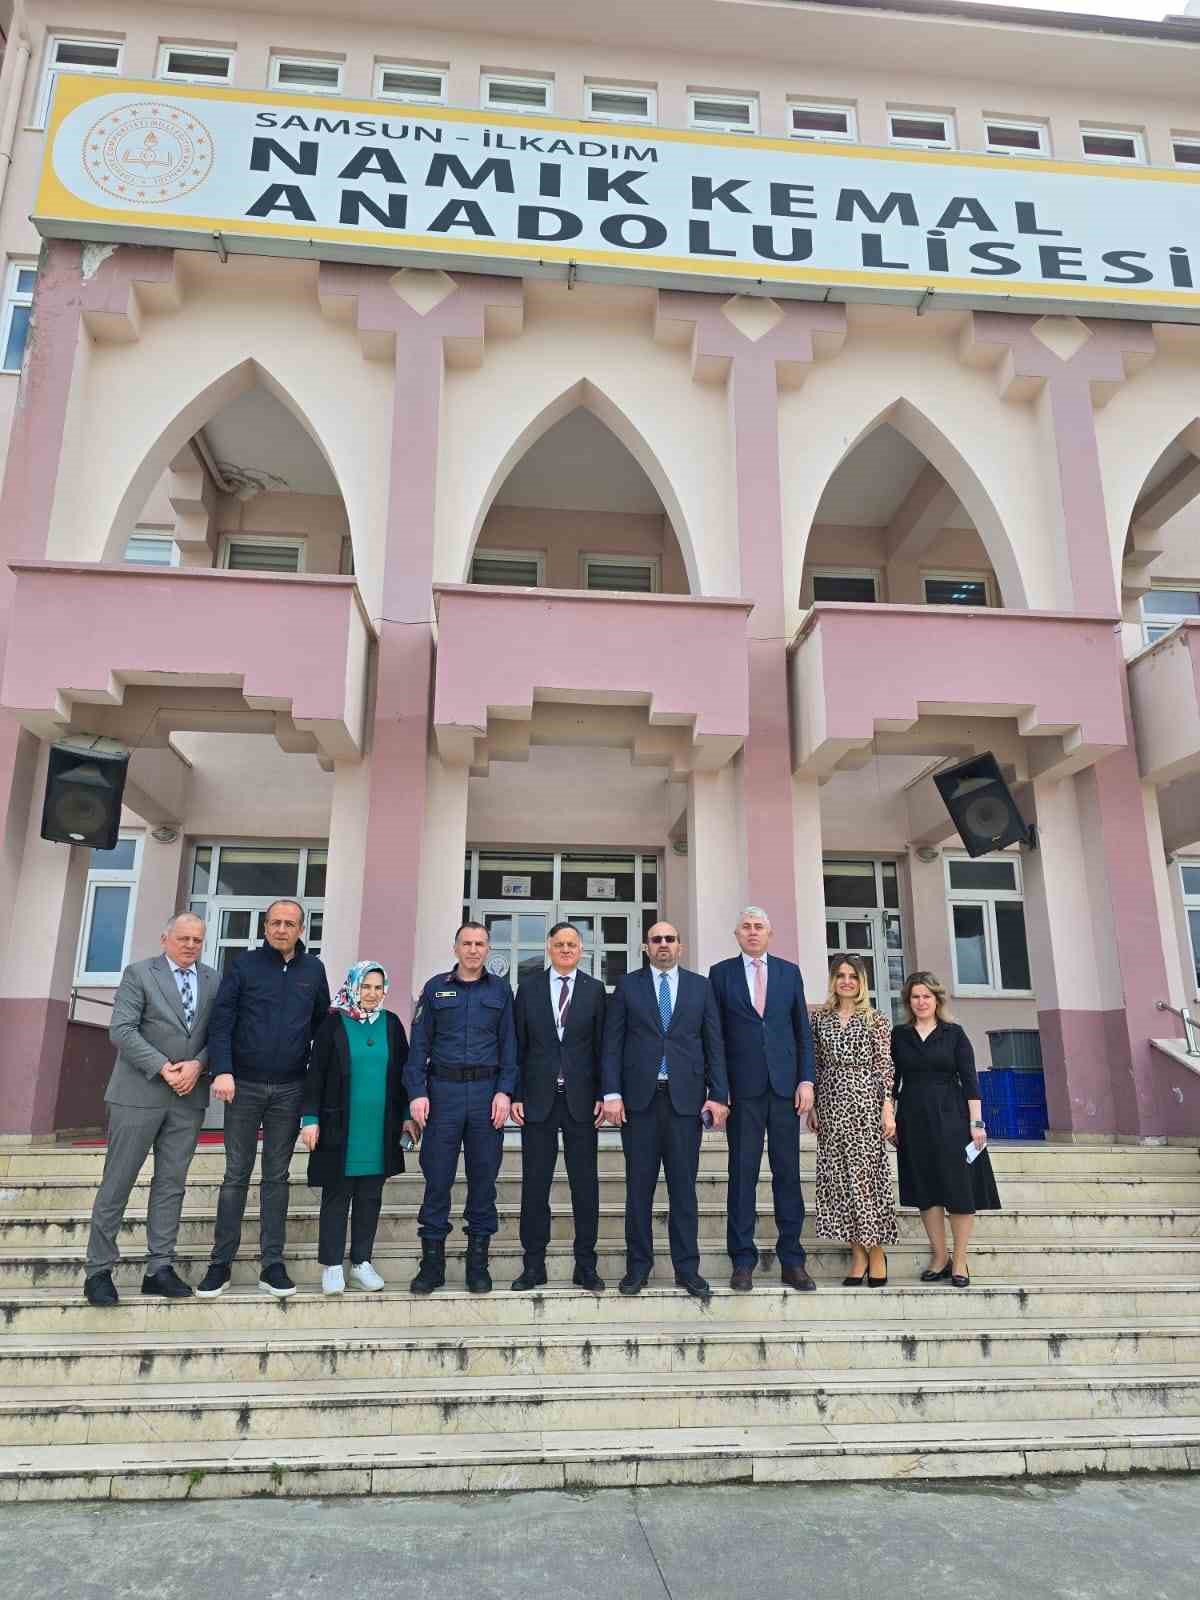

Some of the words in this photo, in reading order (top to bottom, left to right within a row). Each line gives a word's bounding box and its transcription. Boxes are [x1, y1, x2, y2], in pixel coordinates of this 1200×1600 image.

[249, 136, 649, 206] NAMIK
[691, 175, 1063, 237] KEMAL
[255, 112, 443, 143] SAMSUN
[483, 129, 658, 162] İLKADIM
[244, 183, 813, 262] ANADOLU
[861, 229, 1193, 288] LİSESİ
